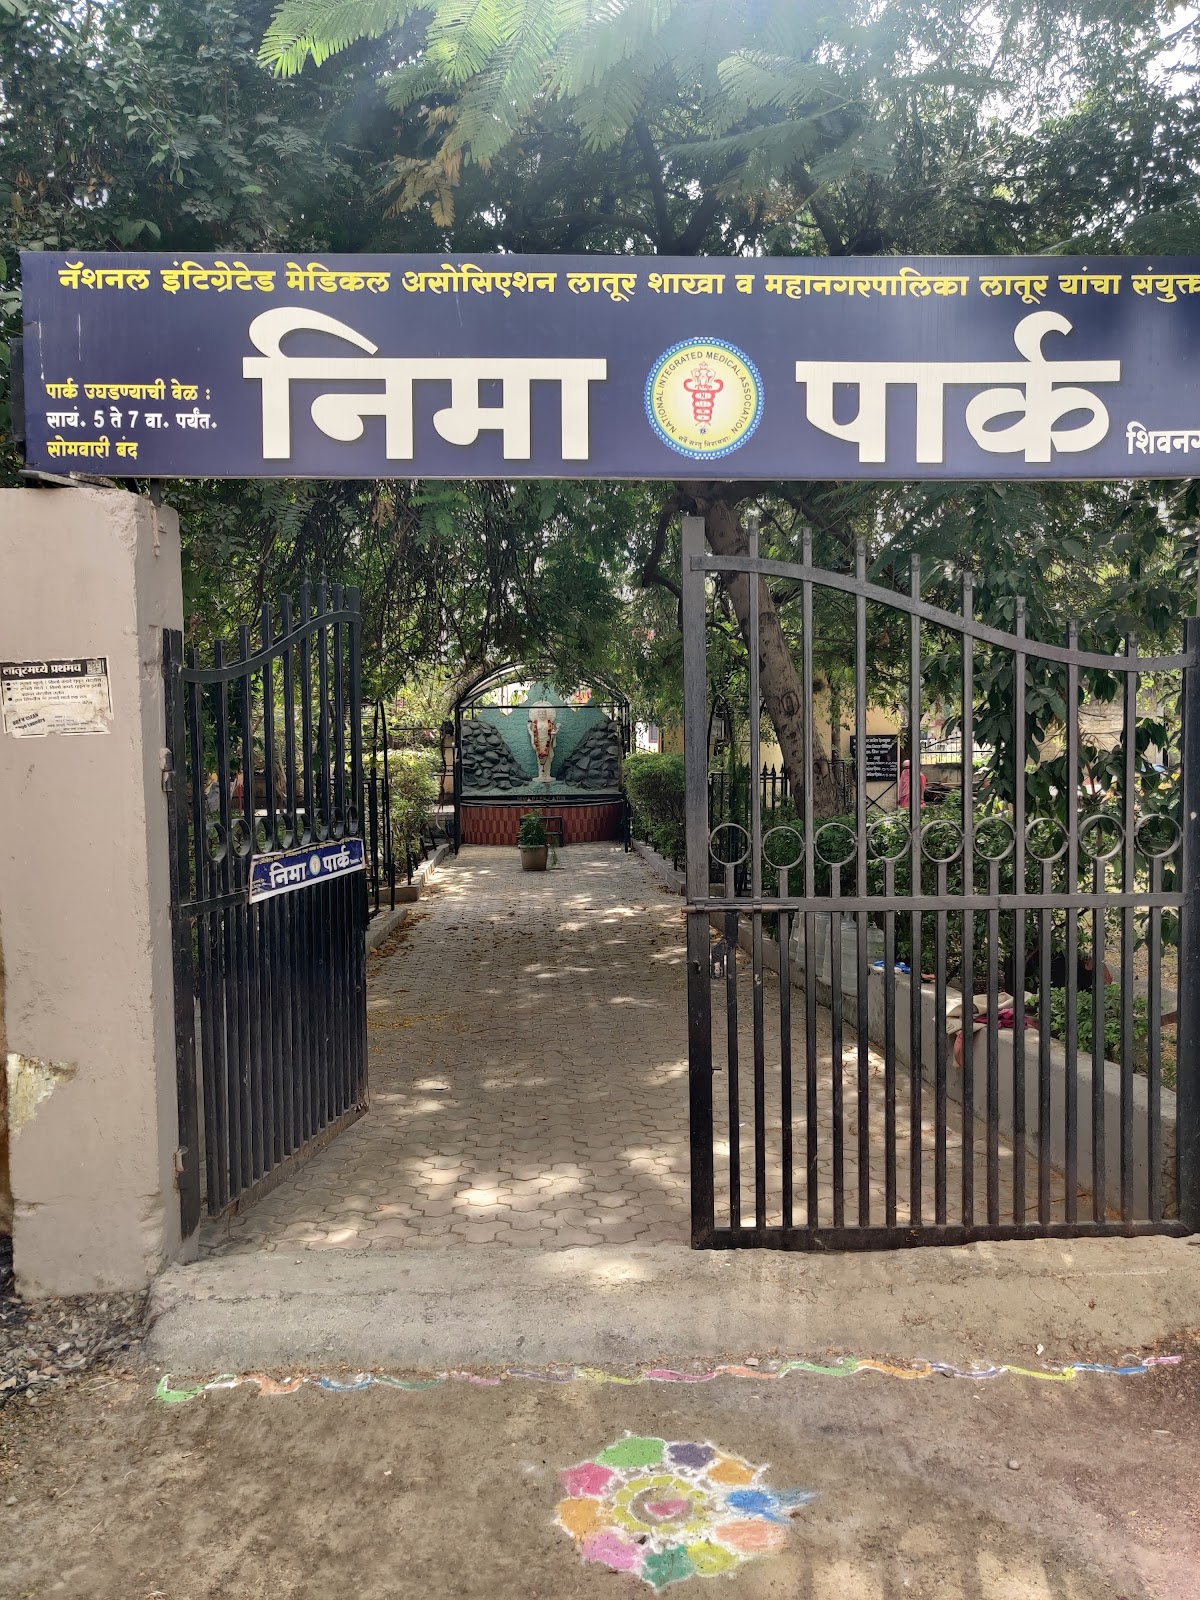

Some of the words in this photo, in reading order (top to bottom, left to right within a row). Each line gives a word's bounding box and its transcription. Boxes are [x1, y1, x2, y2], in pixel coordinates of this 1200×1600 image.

[58, 261, 151, 291] नॅशनल
[160, 261, 276, 295] इंटिग्रेटेड
[286, 262, 390, 293] मेडिकल
[567, 273, 637, 302] लातूर
[648, 273, 725, 295] शाखा
[735, 275, 755, 295] व
[764, 267, 969, 299] महानगरपालिका
[979, 275, 1049, 304] लातूर
[1058, 266, 1122, 295] यांचा
[658, 351, 703, 388] INTEGRATED
[705, 351, 740, 376] MEDICAL
[46, 378, 79, 399] पार्क
[84, 378, 166, 401] उघडण्याची
[171, 378, 198, 401] वेळ
[242, 307, 607, 460] निमा
[795, 311, 1121, 464] पार्क
[731, 376, 752, 434] ASSOCIATION
[46, 405, 86, 428] सायं.
[94, 410, 105, 428] 5
[110, 405, 122, 428] ते
[129, 410, 139, 428] 7
[145, 413, 169, 428] वा.
[656, 390, 677, 434] NATIONAL
[47, 435, 110, 459] सोमवारी
[116, 435, 138, 460] बंद
[269, 861, 307, 889] निमा
[322, 844, 351, 873] पार्क
